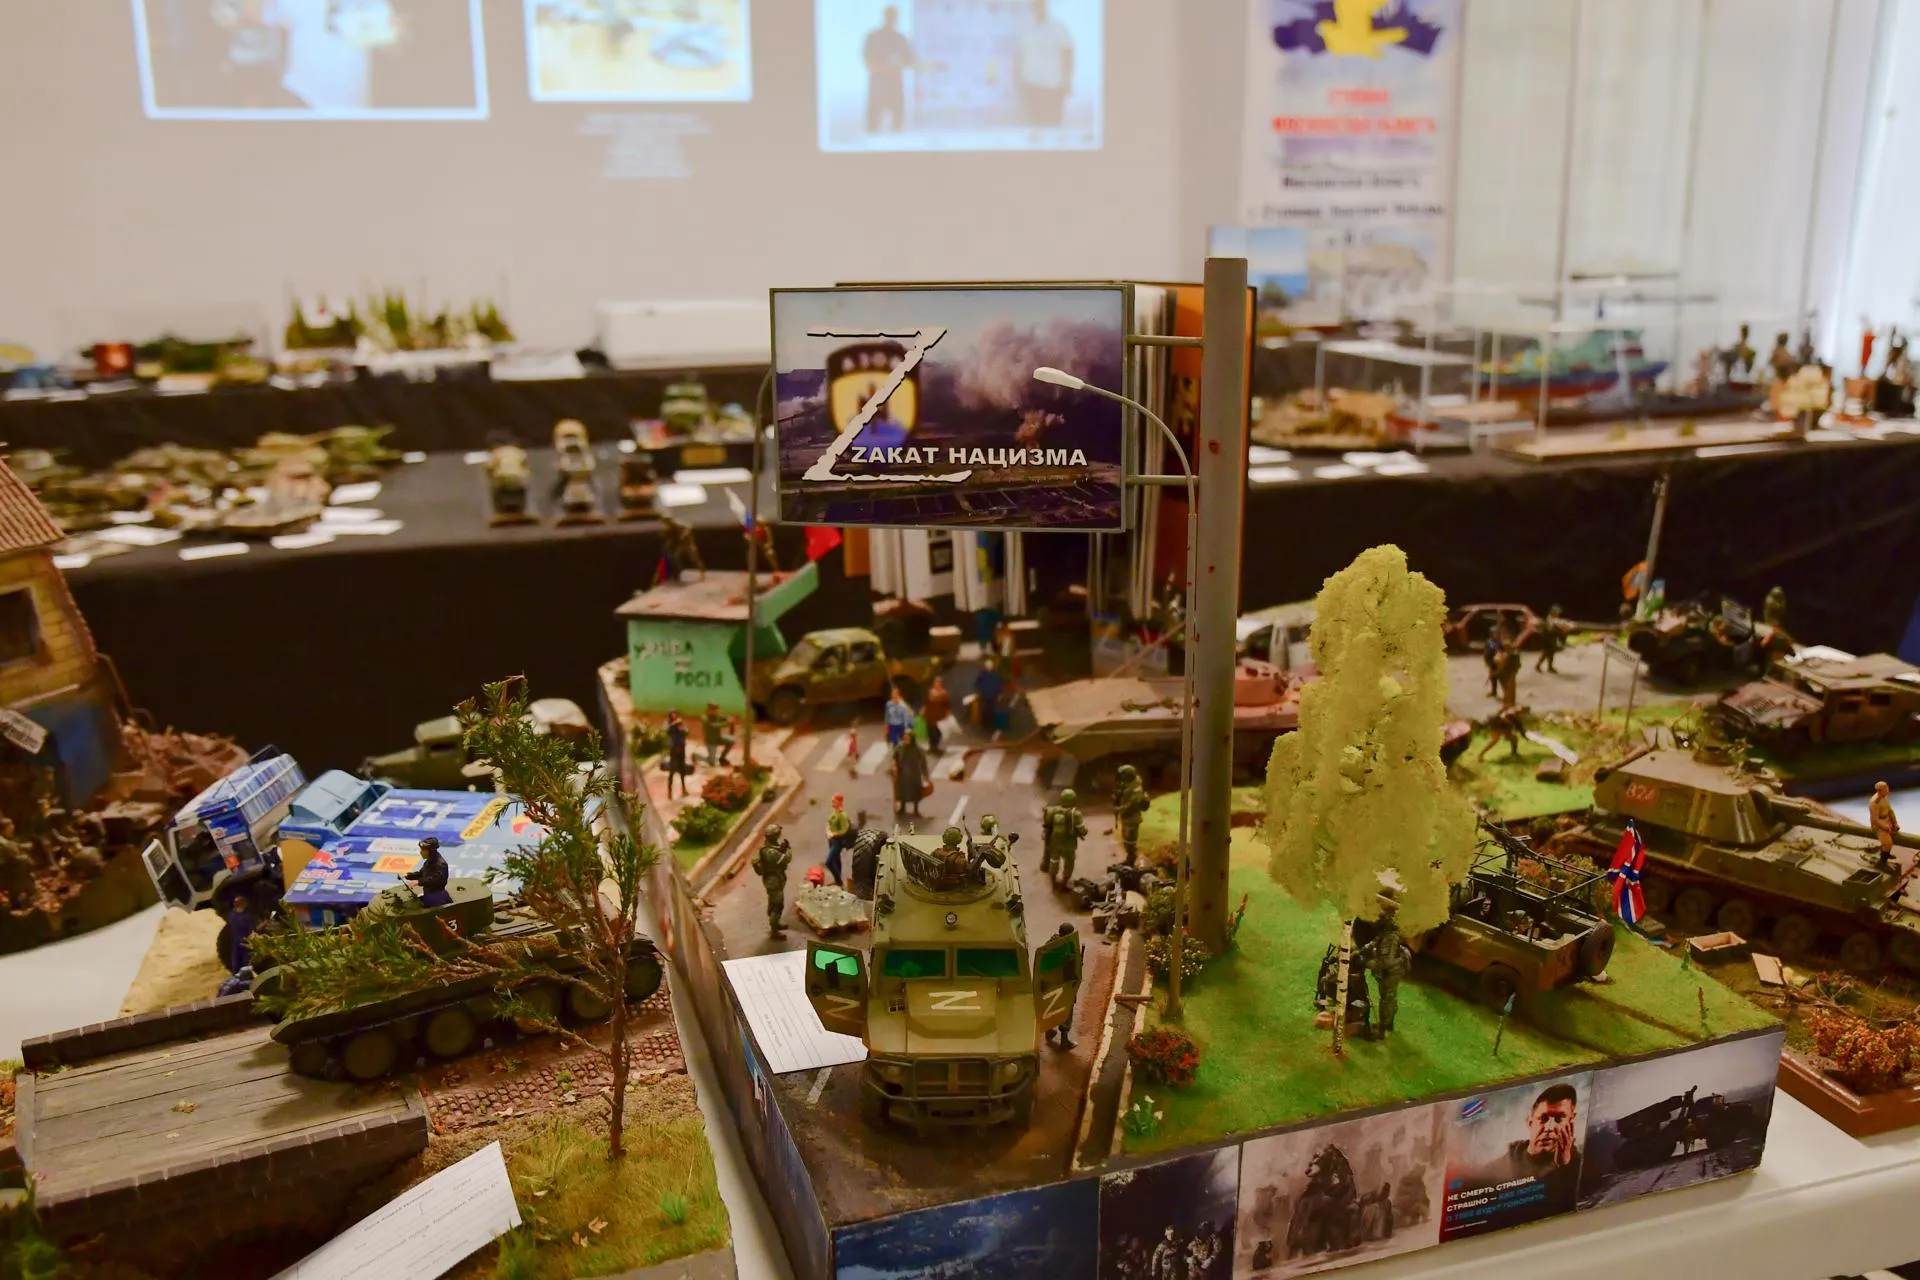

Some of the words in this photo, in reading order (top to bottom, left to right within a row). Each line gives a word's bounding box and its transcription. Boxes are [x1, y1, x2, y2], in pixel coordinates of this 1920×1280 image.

[802, 326, 972, 482] Z
[852, 447, 939, 464] ZАКАТ
[949, 448, 1088, 468] НАЦИЗМА
[449, 919, 458, 931] 3
[928, 990, 981, 1010] Z
[1447, 1193, 1459, 1202] НЕ
[1460, 1186, 1495, 1199] СМЕРТЬ
[1446, 1197, 1488, 1212] СТРАШНО
